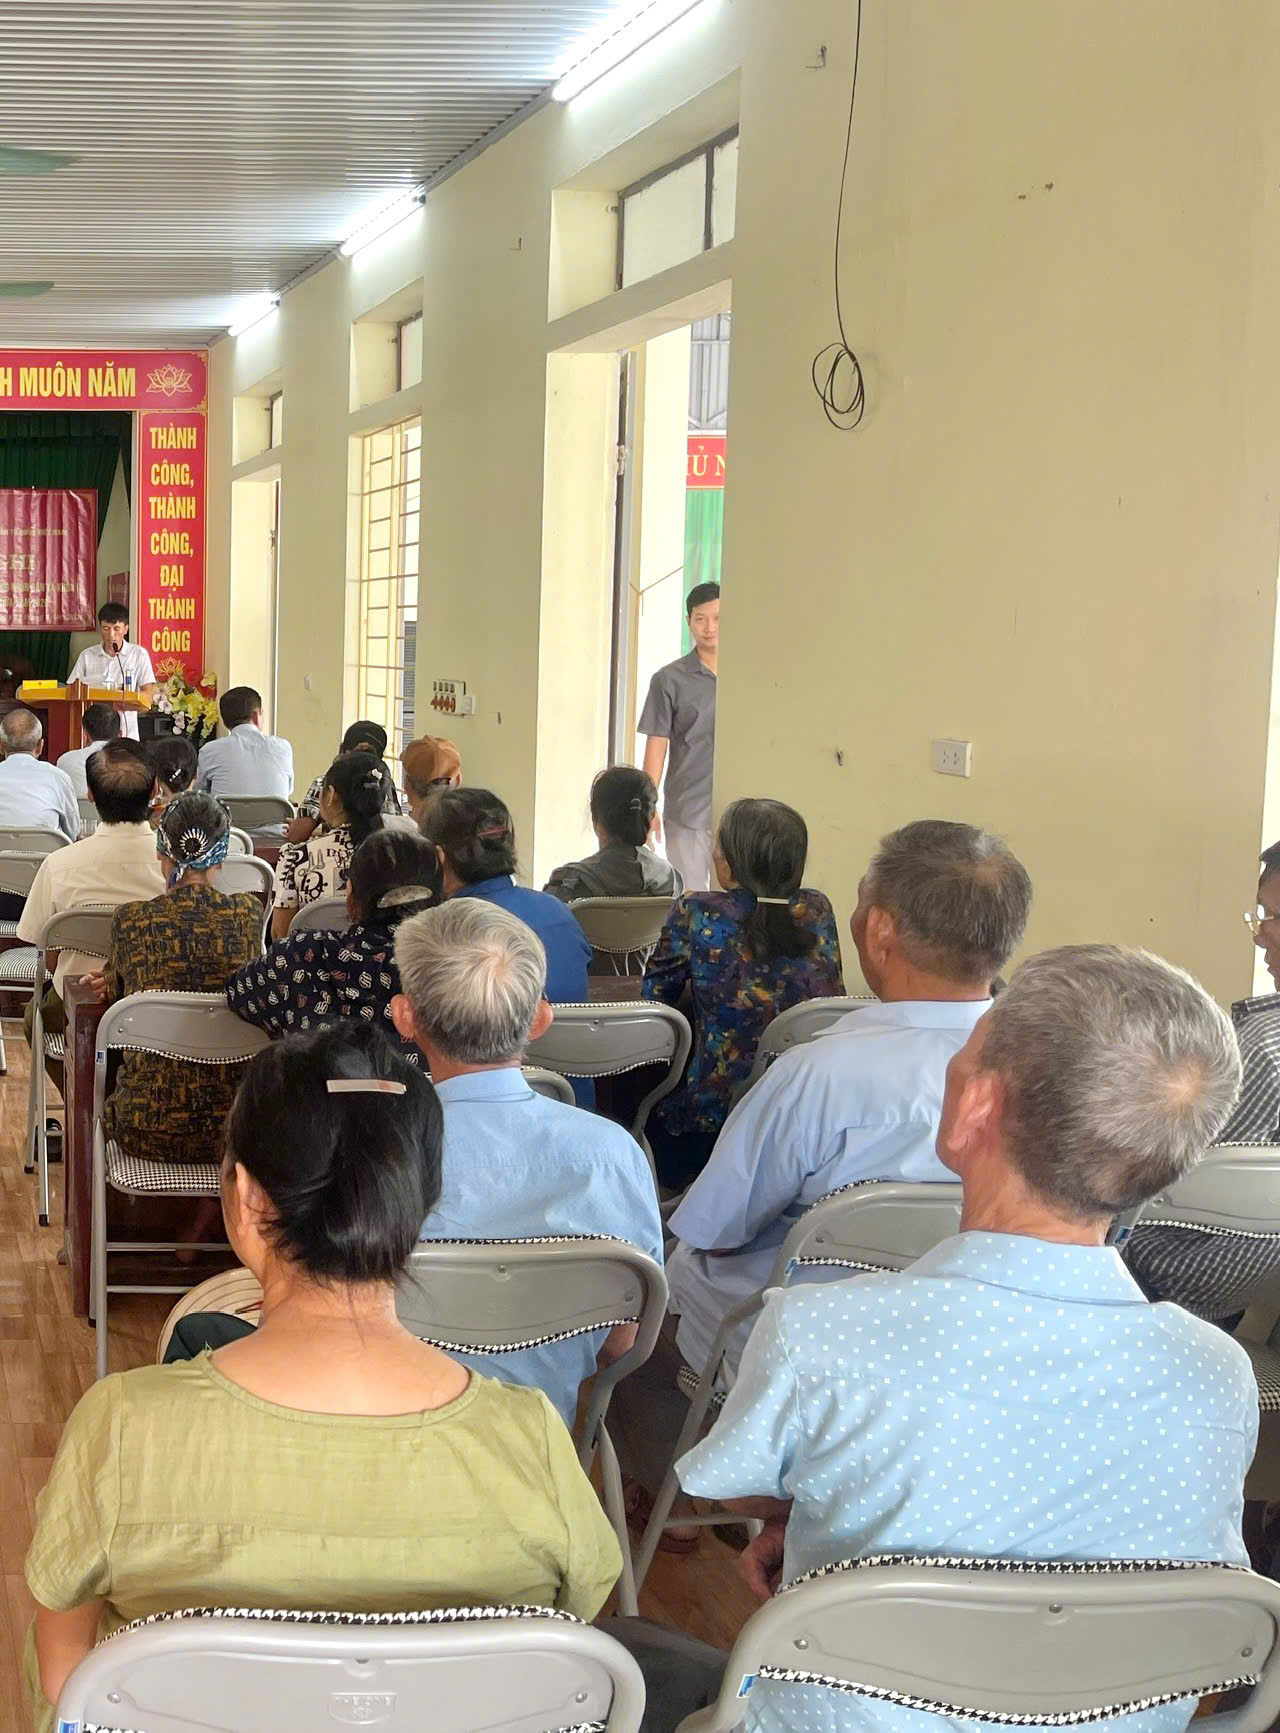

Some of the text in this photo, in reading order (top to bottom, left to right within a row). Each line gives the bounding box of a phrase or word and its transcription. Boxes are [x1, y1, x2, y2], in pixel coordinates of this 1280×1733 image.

[19, 361, 82, 397] MUÔN
[88, 360, 136, 397] NĂM
[149, 422, 197, 449] THÀNH
[150, 459, 194, 488] CÔNG,
[148, 492, 196, 519] THÀNH
[150, 528, 194, 557] CÔNG,
[159, 565, 185, 592] ĐẠI
[148, 593, 196, 620] THÀNH
[151, 626, 191, 652] CÔNG
